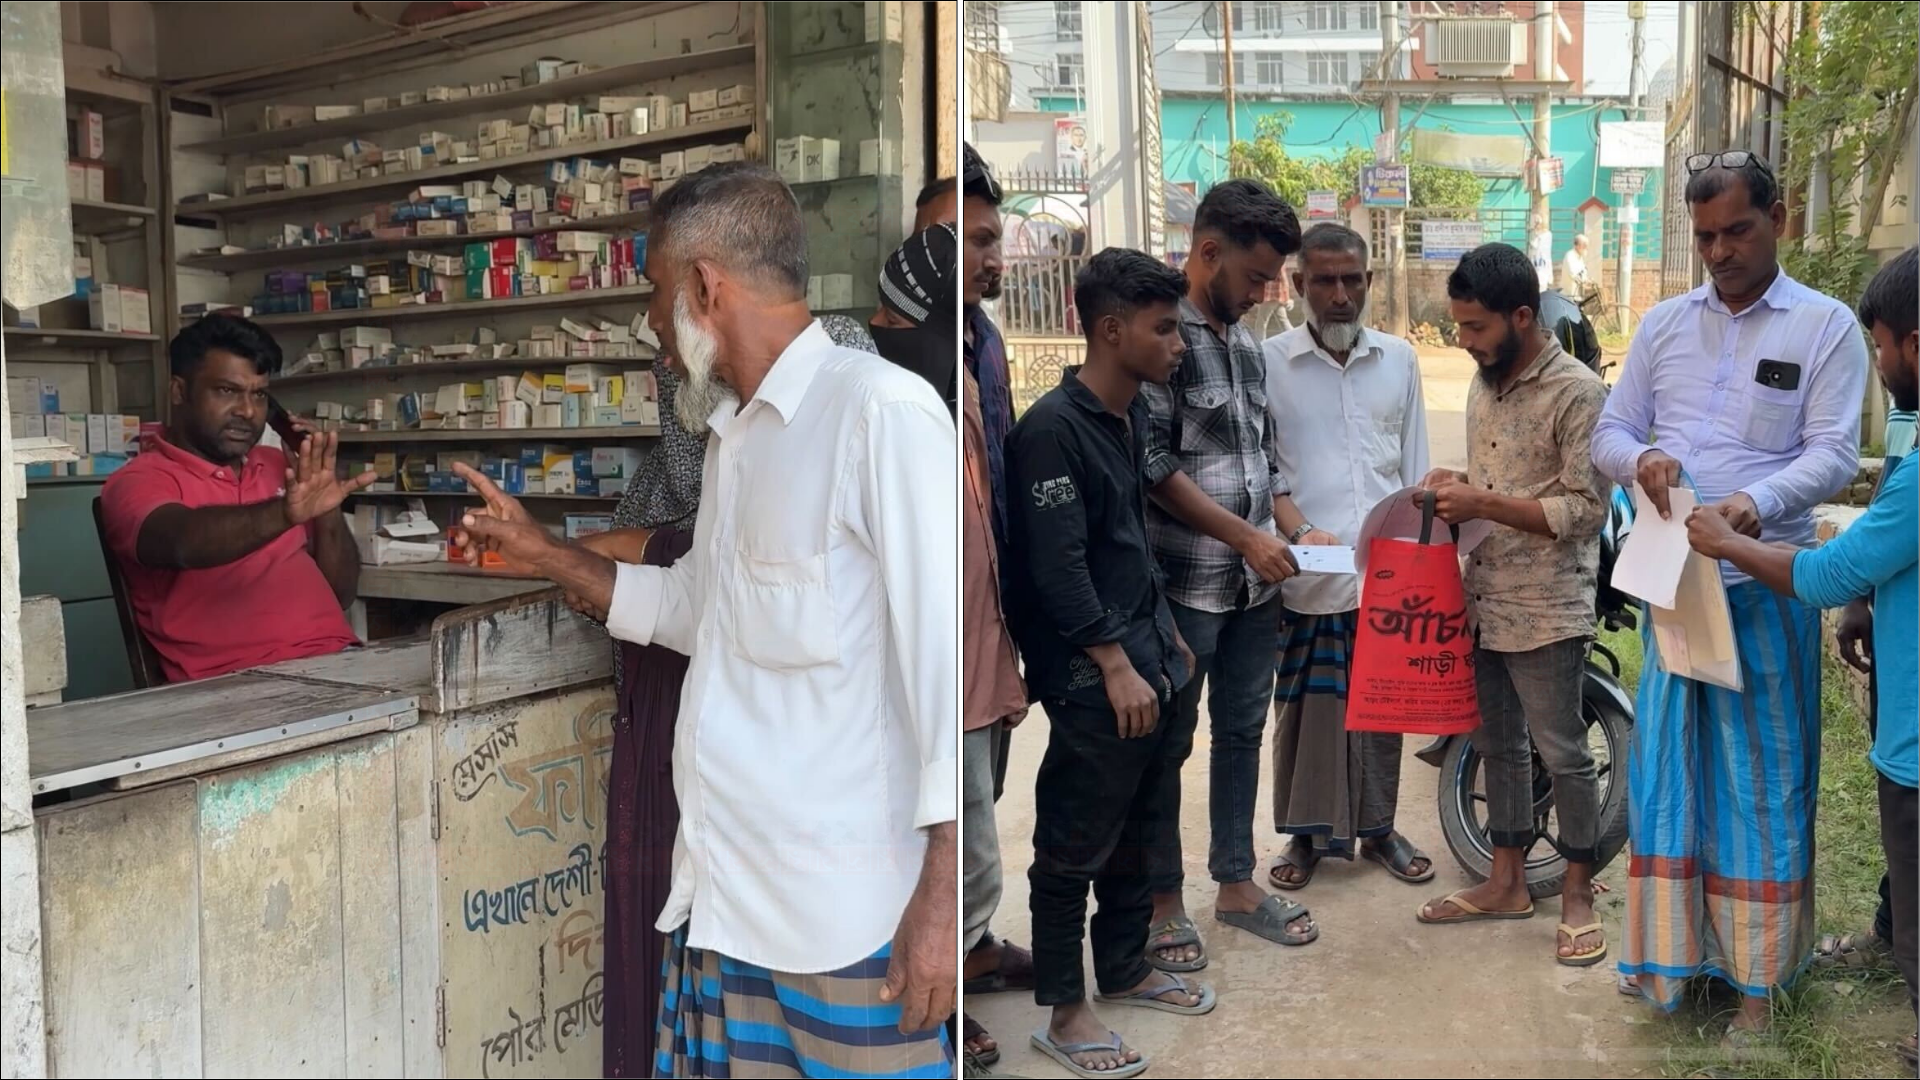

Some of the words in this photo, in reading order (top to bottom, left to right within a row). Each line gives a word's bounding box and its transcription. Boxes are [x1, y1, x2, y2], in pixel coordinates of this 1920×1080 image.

[806, 153, 821, 167] DK
[1406, 651, 1460, 678] শাড়ী
[463, 877, 540, 934] এখানে
[481, 1005, 546, 1079] পৌর
